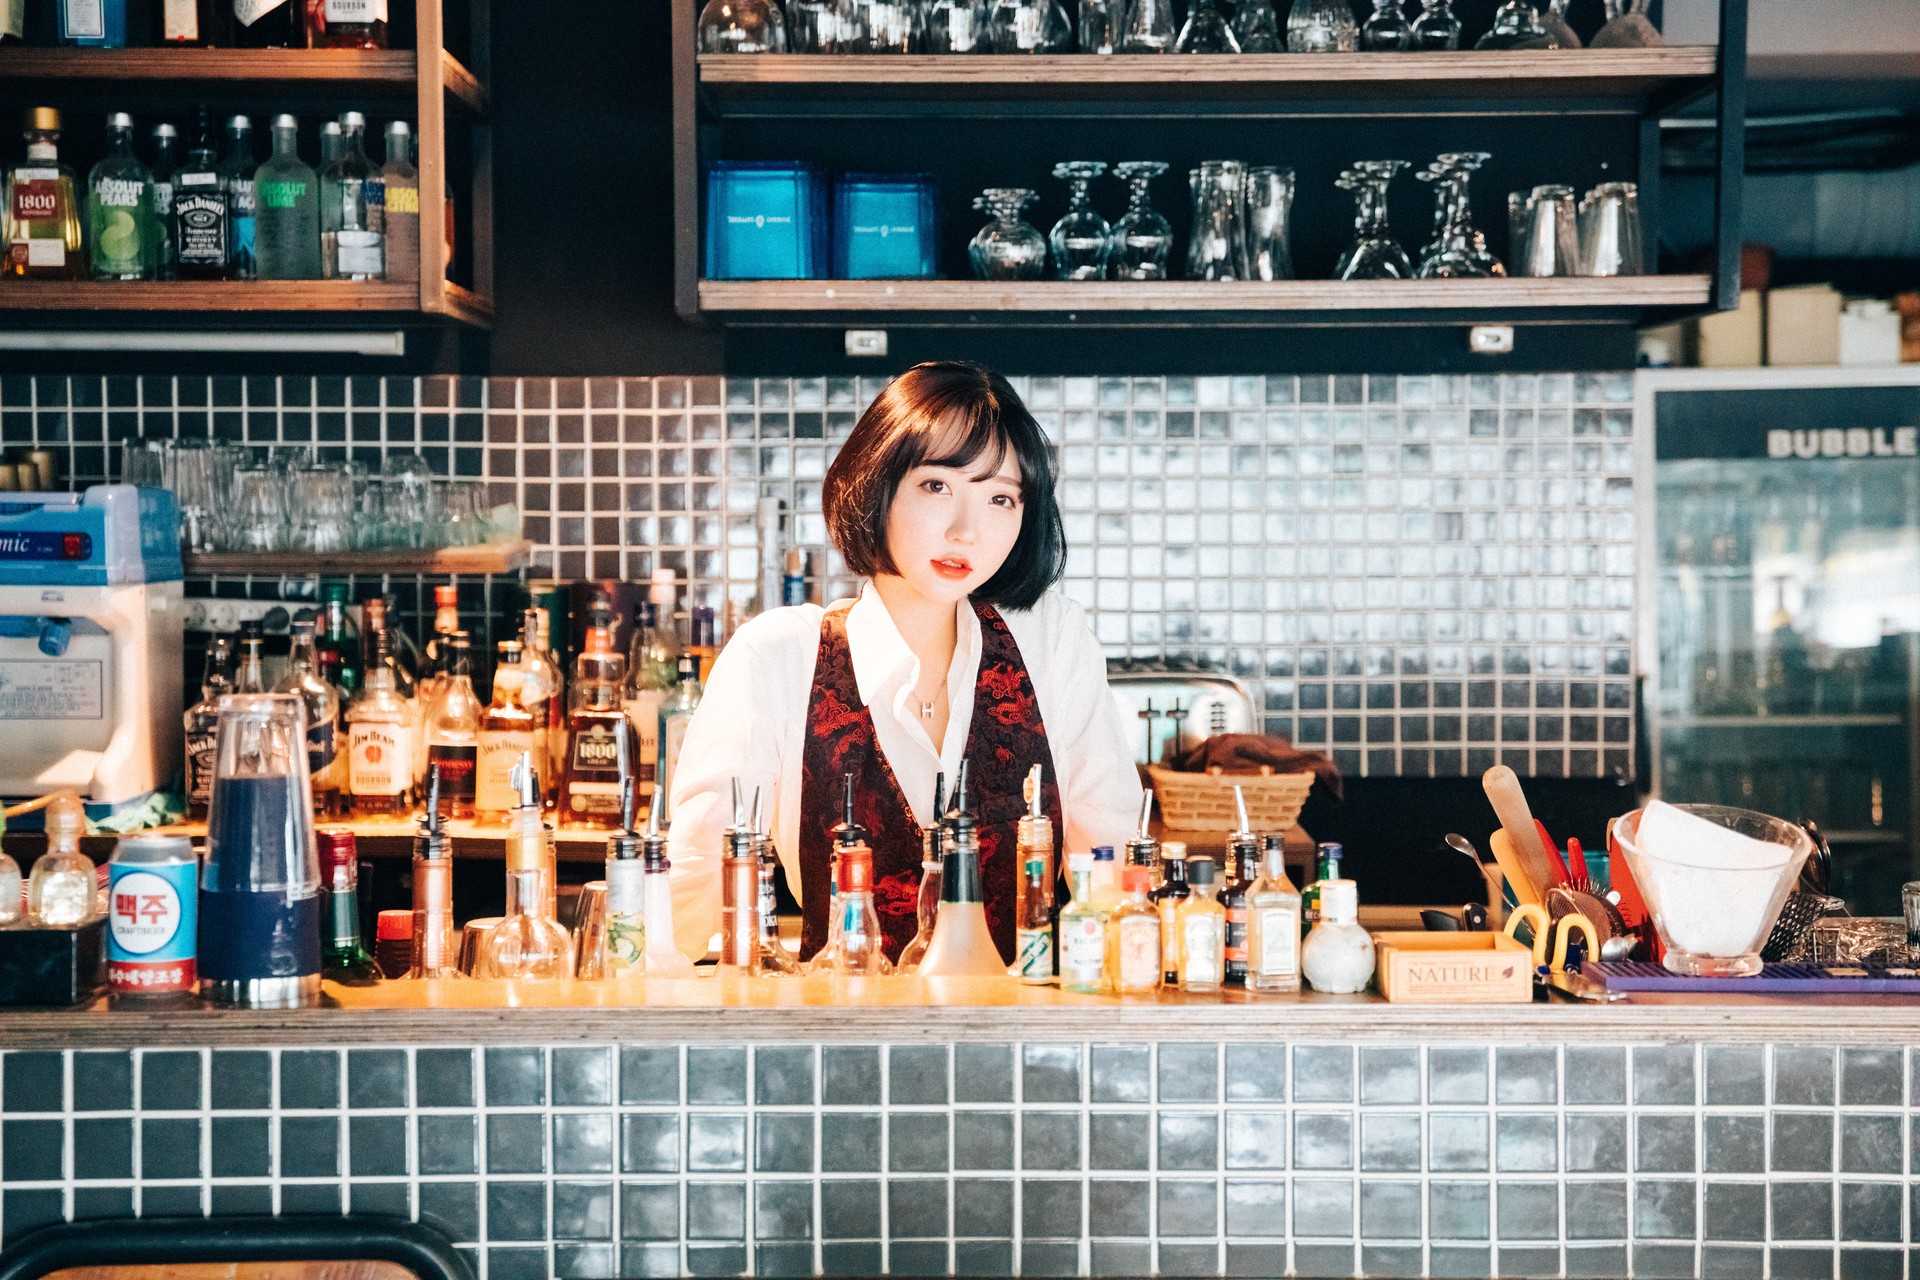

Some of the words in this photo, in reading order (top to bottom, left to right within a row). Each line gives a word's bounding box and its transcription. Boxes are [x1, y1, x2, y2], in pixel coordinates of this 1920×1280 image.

[19, 194, 56, 209] 1800
[100, 194, 138, 207] PEARS
[1767, 427, 1918, 458] BUBBLE
[579, 743, 618, 760] 1800
[116, 893, 168, 925] 맥주
[1408, 965, 1498, 983] NATURE
